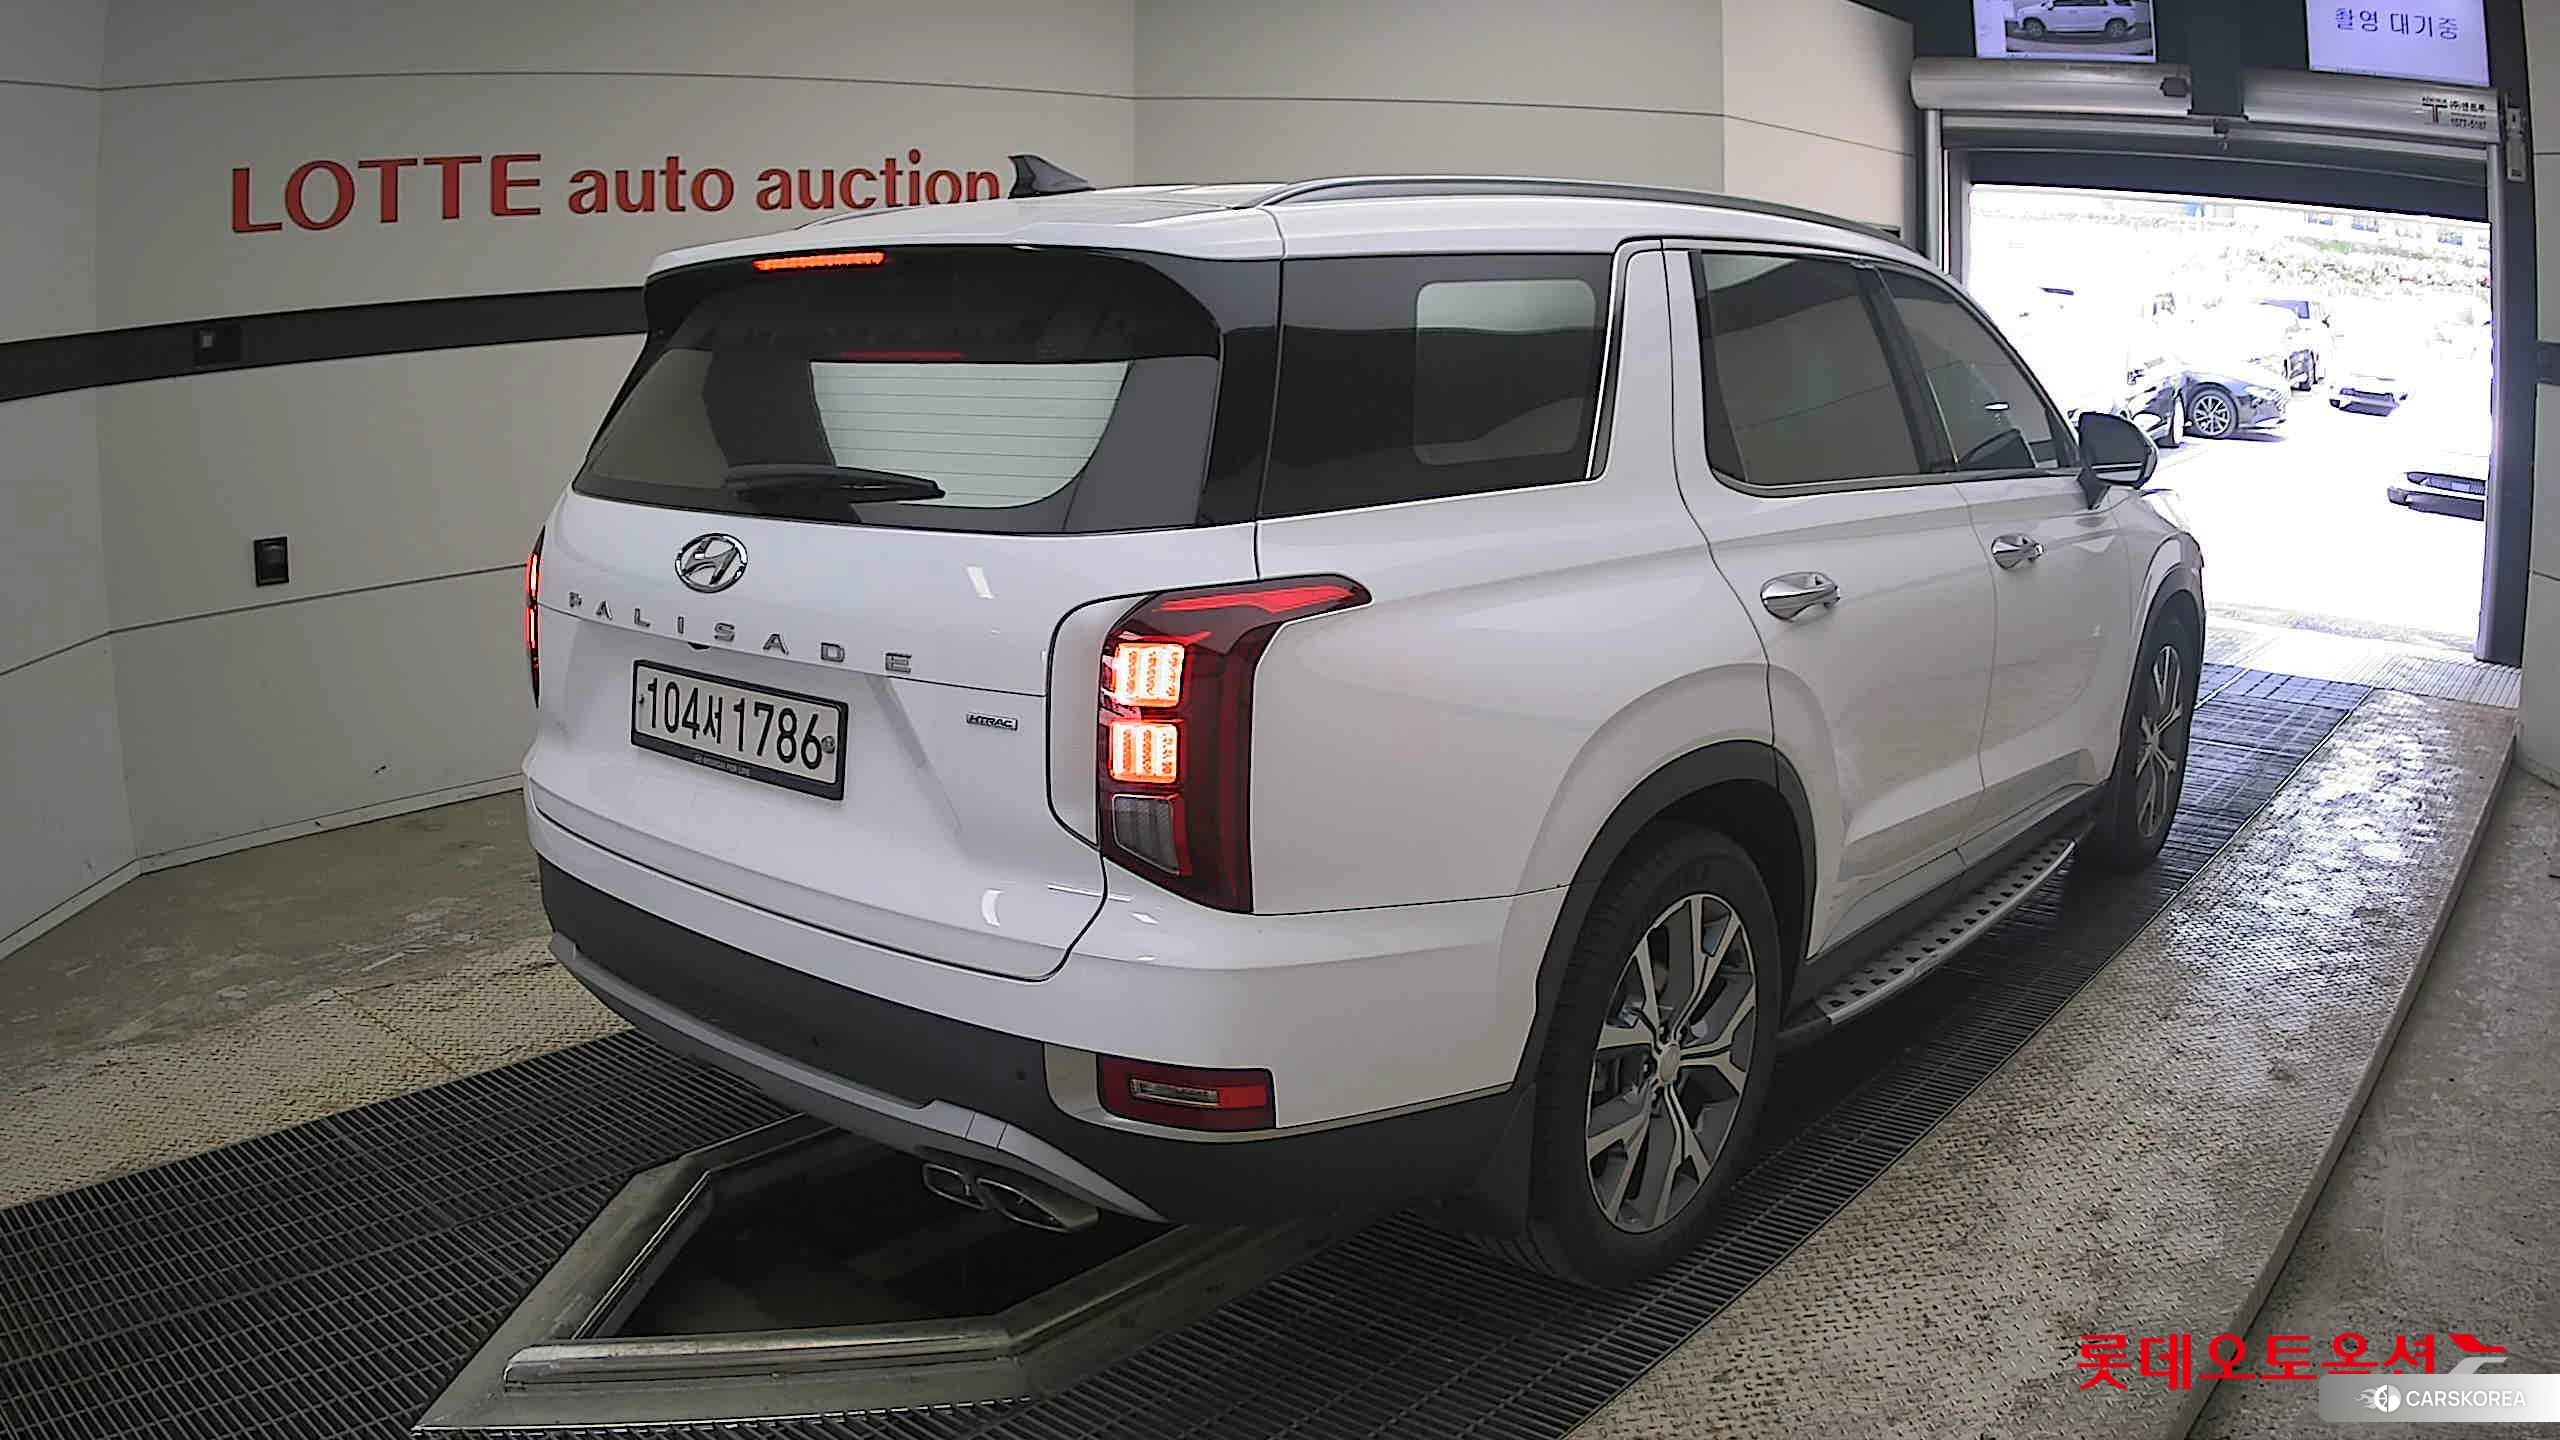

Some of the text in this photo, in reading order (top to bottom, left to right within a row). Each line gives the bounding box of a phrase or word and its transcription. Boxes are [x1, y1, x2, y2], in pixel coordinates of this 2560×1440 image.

[2335, 7, 2458, 40] 촬영 대기중
[232, 148, 1001, 233] LOTTE auto auction
[568, 591, 913, 674] PALISADE
[647, 677, 823, 770] 104서1786
